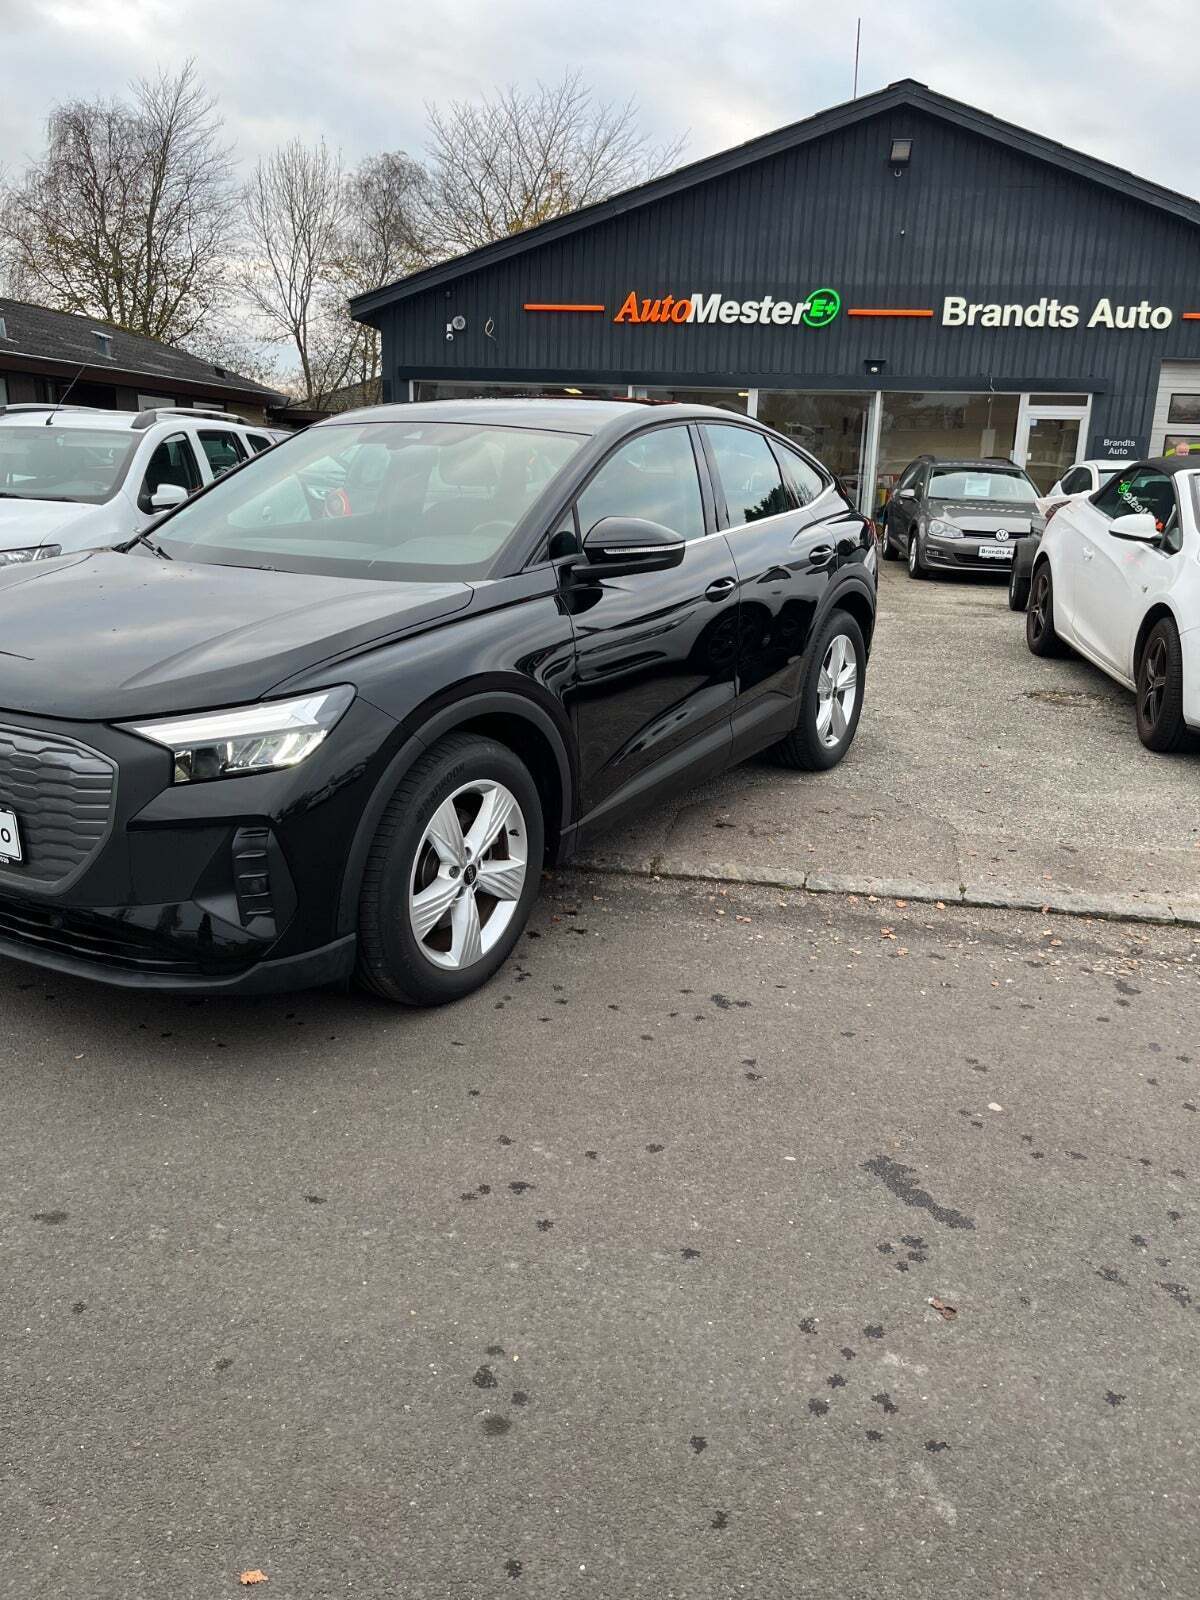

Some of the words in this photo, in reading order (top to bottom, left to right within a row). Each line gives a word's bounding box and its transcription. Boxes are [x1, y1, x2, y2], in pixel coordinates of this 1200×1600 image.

[942, 296, 1079, 328] Brandts
[1087, 298, 1173, 330] Auto
[1103, 439, 1136, 447] Brandts
[1108, 447, 1128, 455] Auto
